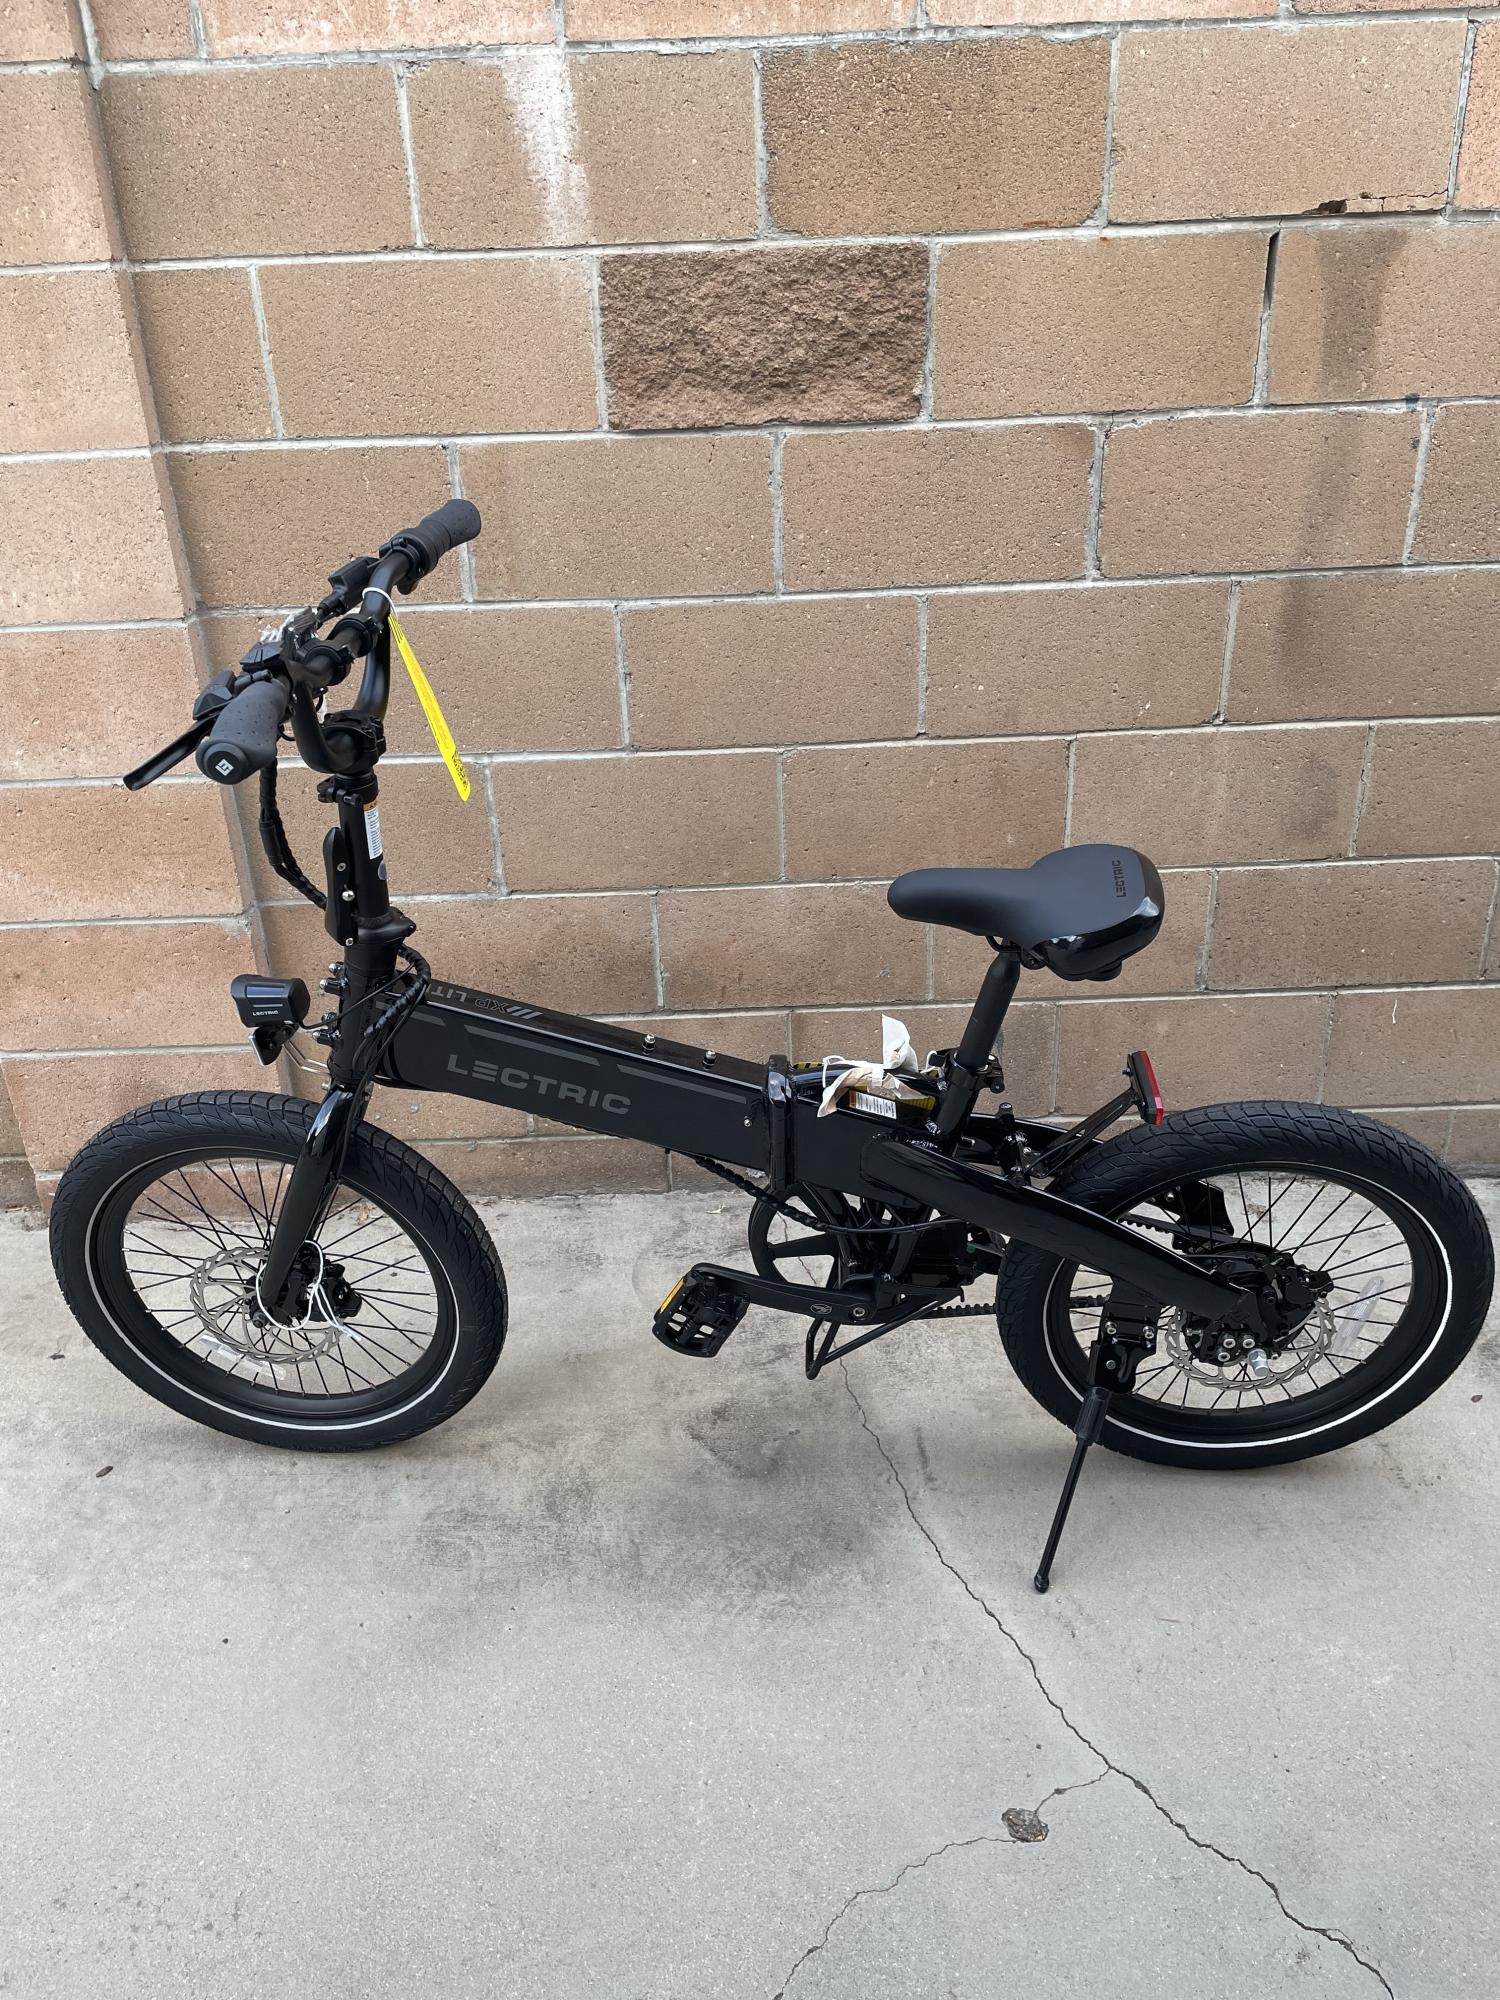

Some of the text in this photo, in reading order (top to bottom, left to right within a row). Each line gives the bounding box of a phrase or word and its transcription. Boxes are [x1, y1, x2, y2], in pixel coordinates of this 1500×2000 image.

[1112, 859, 1127, 898] LECTRIC
[425, 984, 508, 1014] XP LIT
[447, 1054, 632, 1115] LECTRIC
